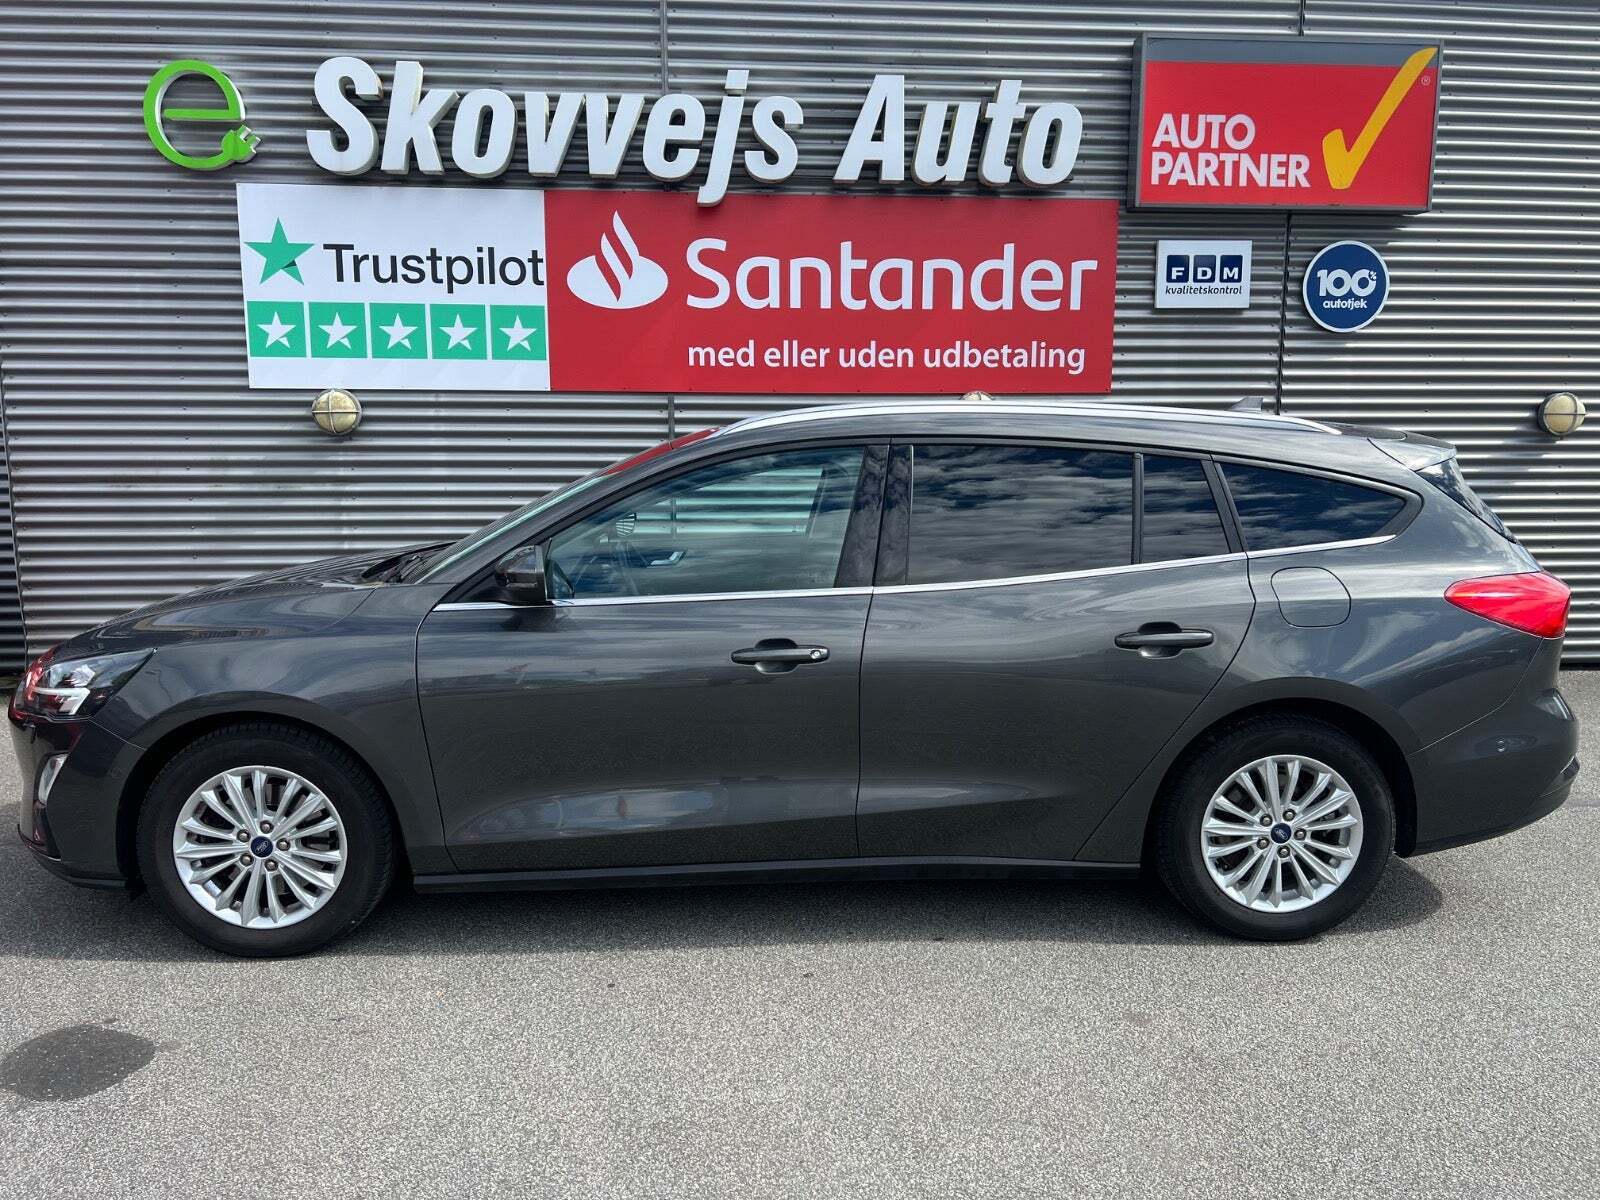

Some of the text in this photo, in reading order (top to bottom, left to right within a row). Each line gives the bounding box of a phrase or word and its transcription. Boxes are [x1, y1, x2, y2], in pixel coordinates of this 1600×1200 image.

[306, 56, 1084, 207] Skovvejs Auto
[1151, 113, 1256, 151] AUTO
[1150, 151, 1311, 188] PARTNER
[323, 243, 544, 294] Trustpilot
[686, 238, 1098, 311] Santander
[1171, 267, 1239, 280] FDM
[1165, 286, 1243, 295] kvalitetskontrol
[687, 340, 1086, 375] med eller uden udbetaling
